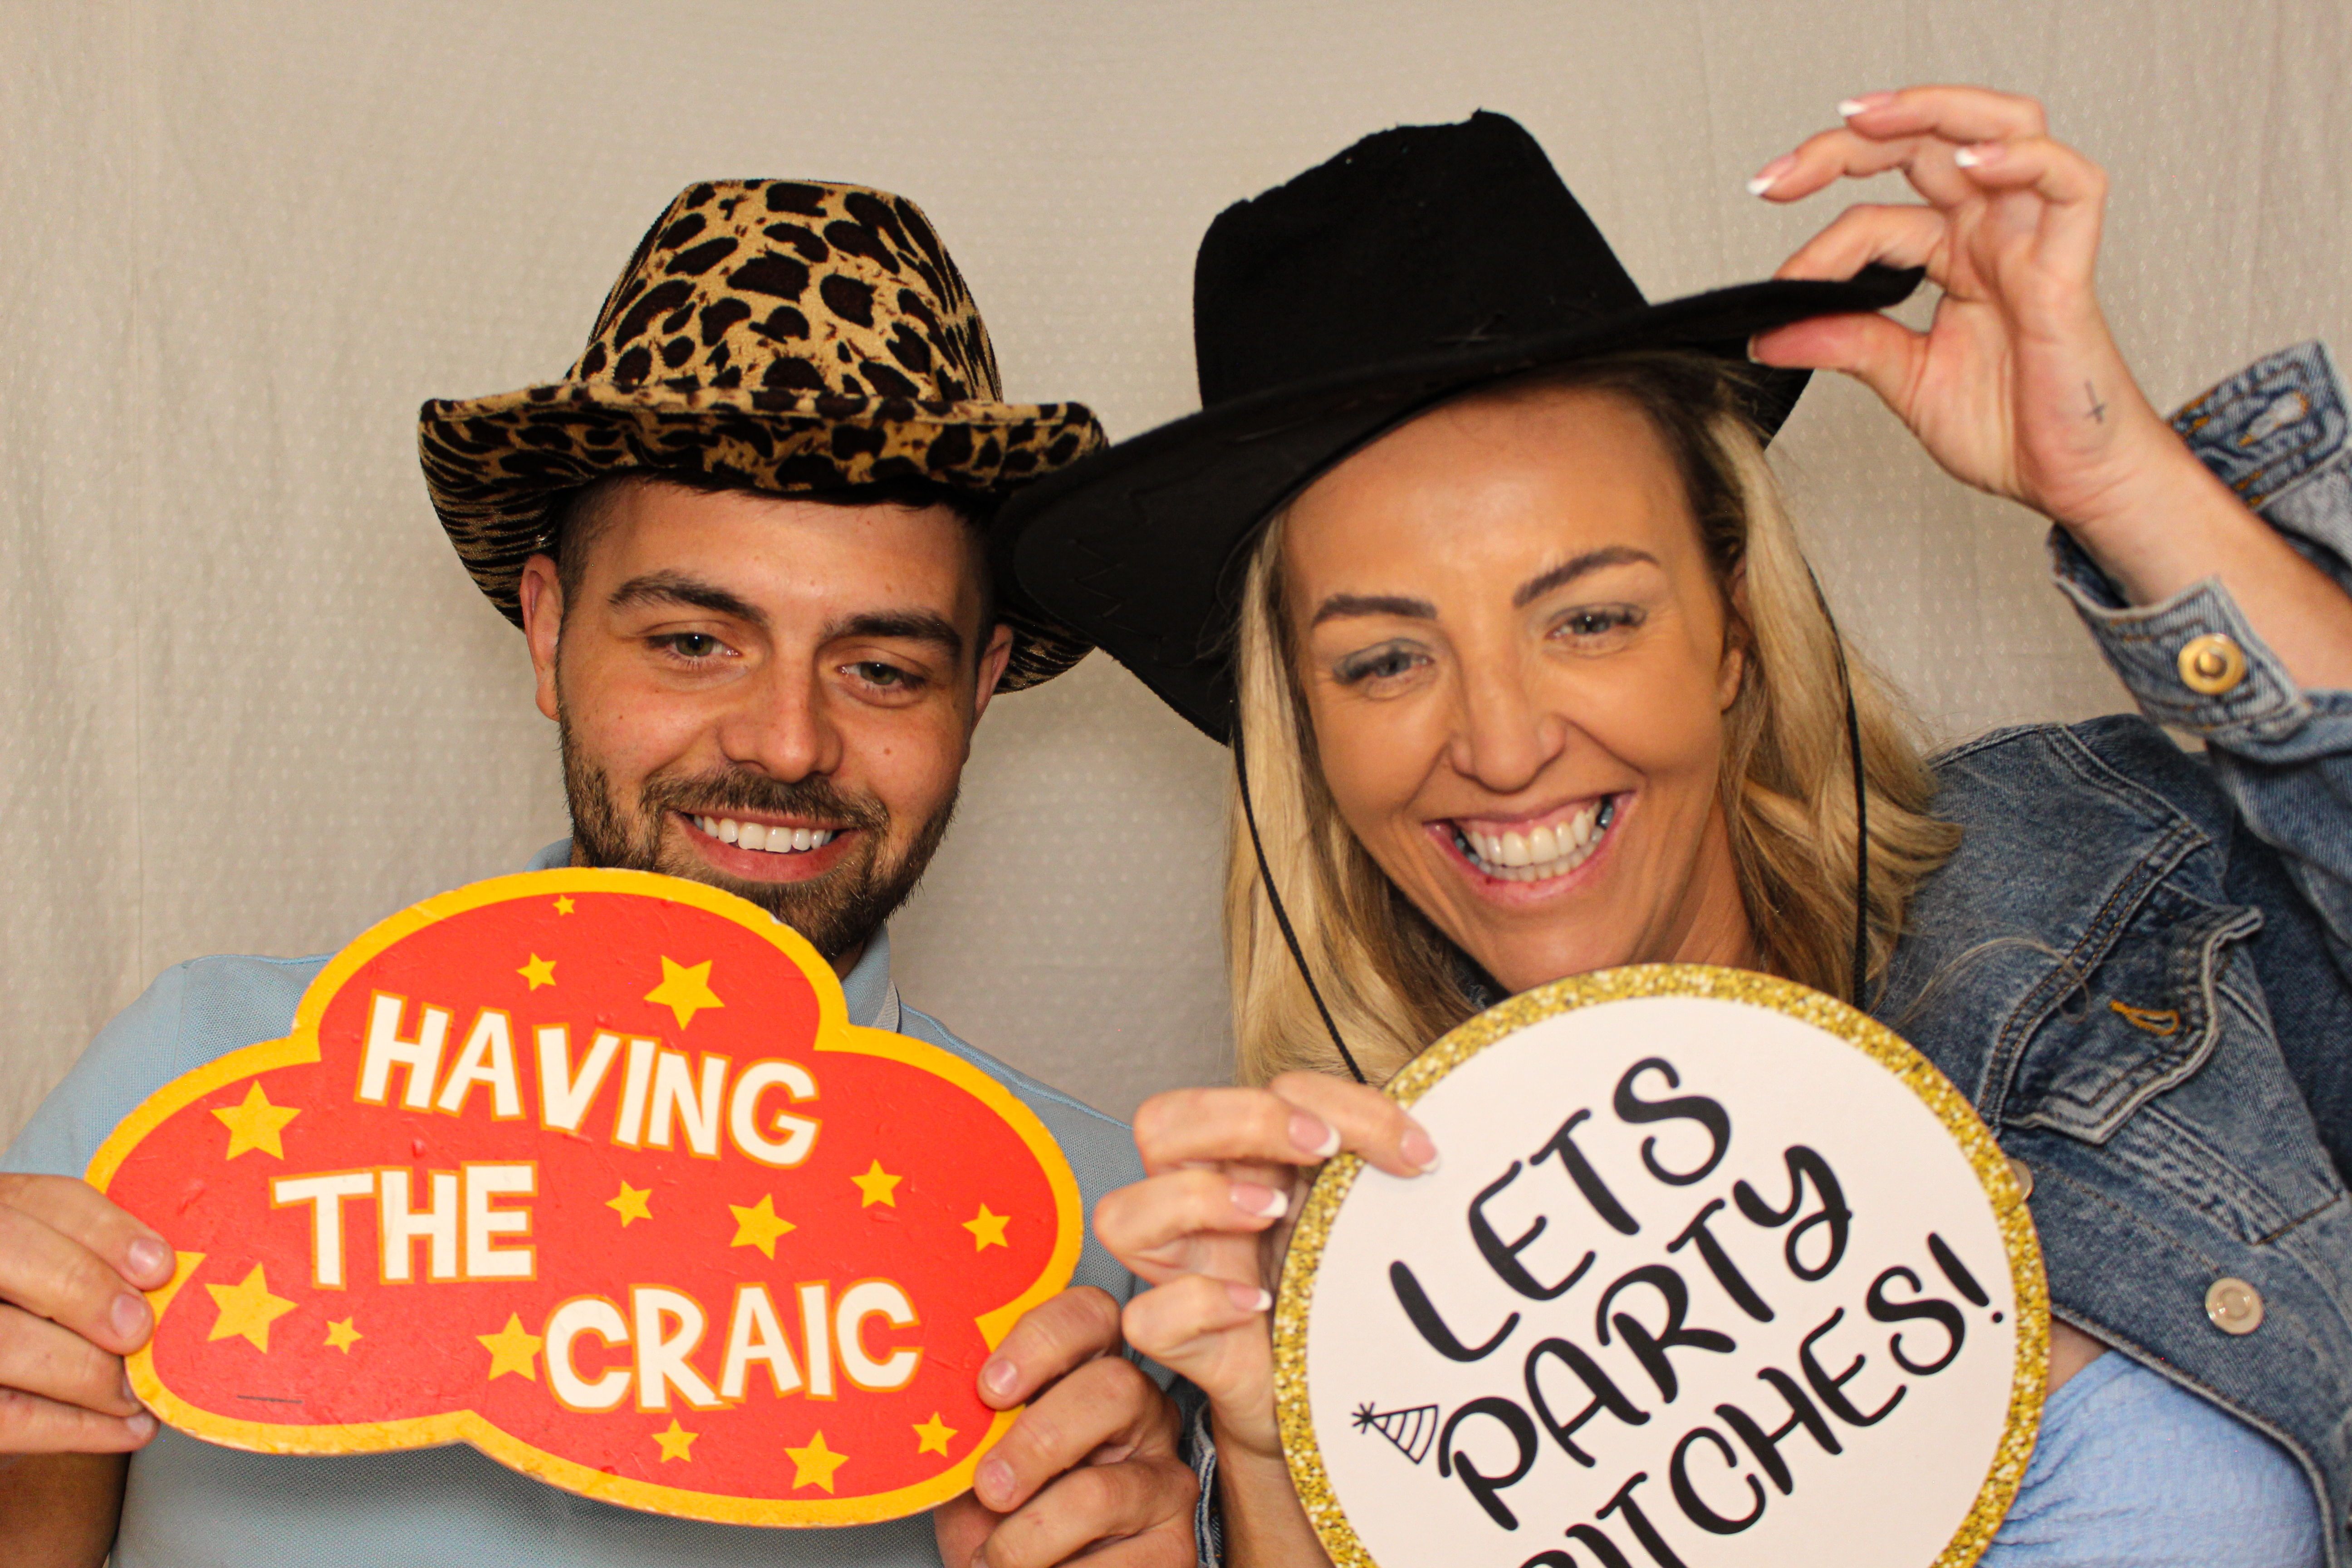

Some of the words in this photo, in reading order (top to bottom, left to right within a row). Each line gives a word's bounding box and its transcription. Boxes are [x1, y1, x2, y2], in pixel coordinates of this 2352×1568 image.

[358, 992, 818, 1167] HAVING
[272, 1162, 535, 1289] THE
[1390, 1057, 1731, 1362] LETS
[544, 1279, 919, 1411] CRAIC
[1438, 1144, 1852, 1531] PARTY
[1519, 1232, 2005, 1568] ITCHES!
